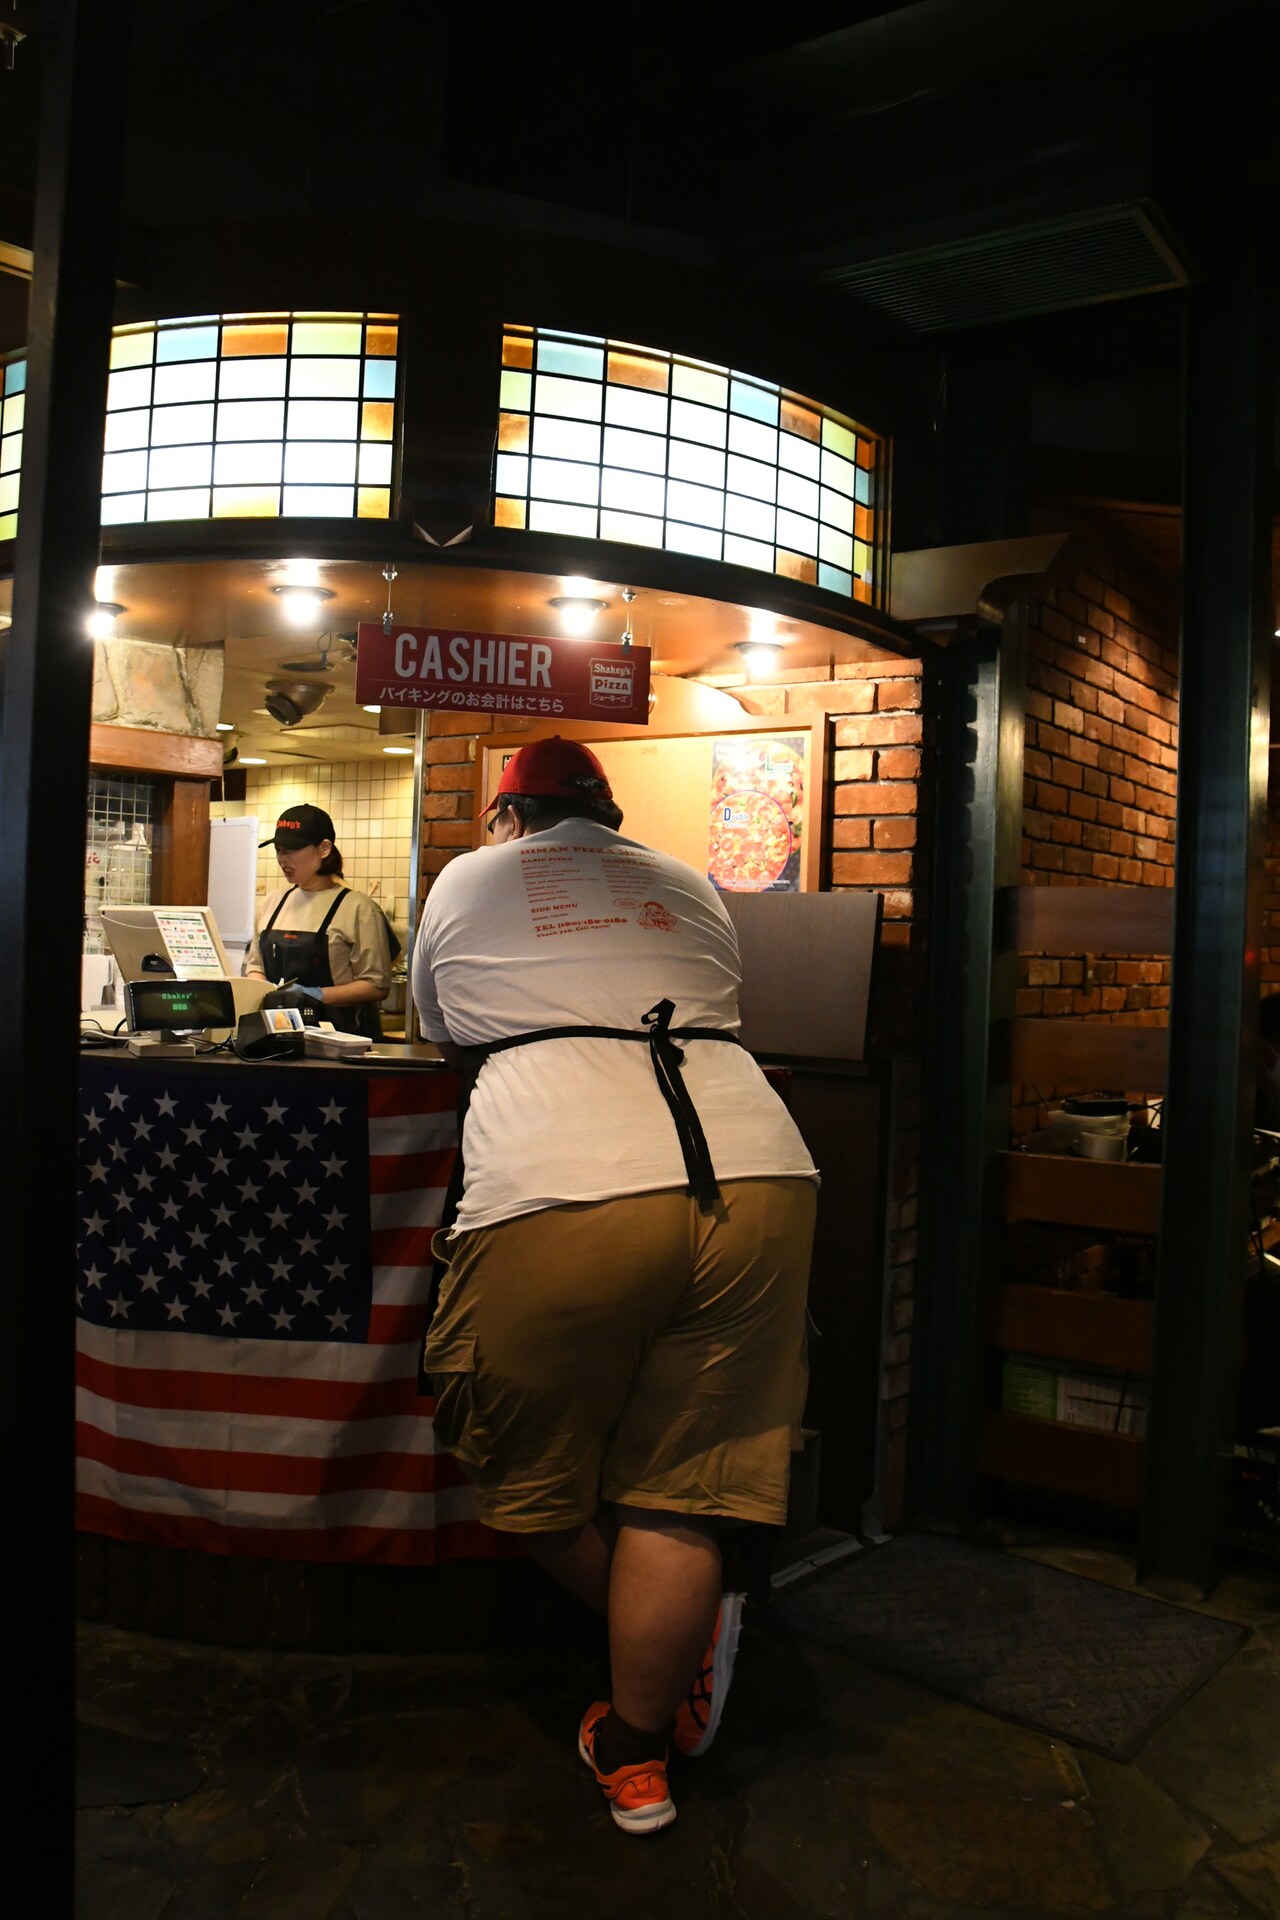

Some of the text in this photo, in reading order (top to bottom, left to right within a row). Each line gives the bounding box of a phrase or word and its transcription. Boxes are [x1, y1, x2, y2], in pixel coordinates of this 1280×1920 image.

[395, 633, 553, 688] CASHIER
[594, 663, 631, 677] Shakey's
[379, 687, 565, 713] バイキングのお会計はこちら
[553, 903, 578, 911] MENU
[535, 924, 556, 932] TEL
[161, 992, 197, 1000] Shakey'
